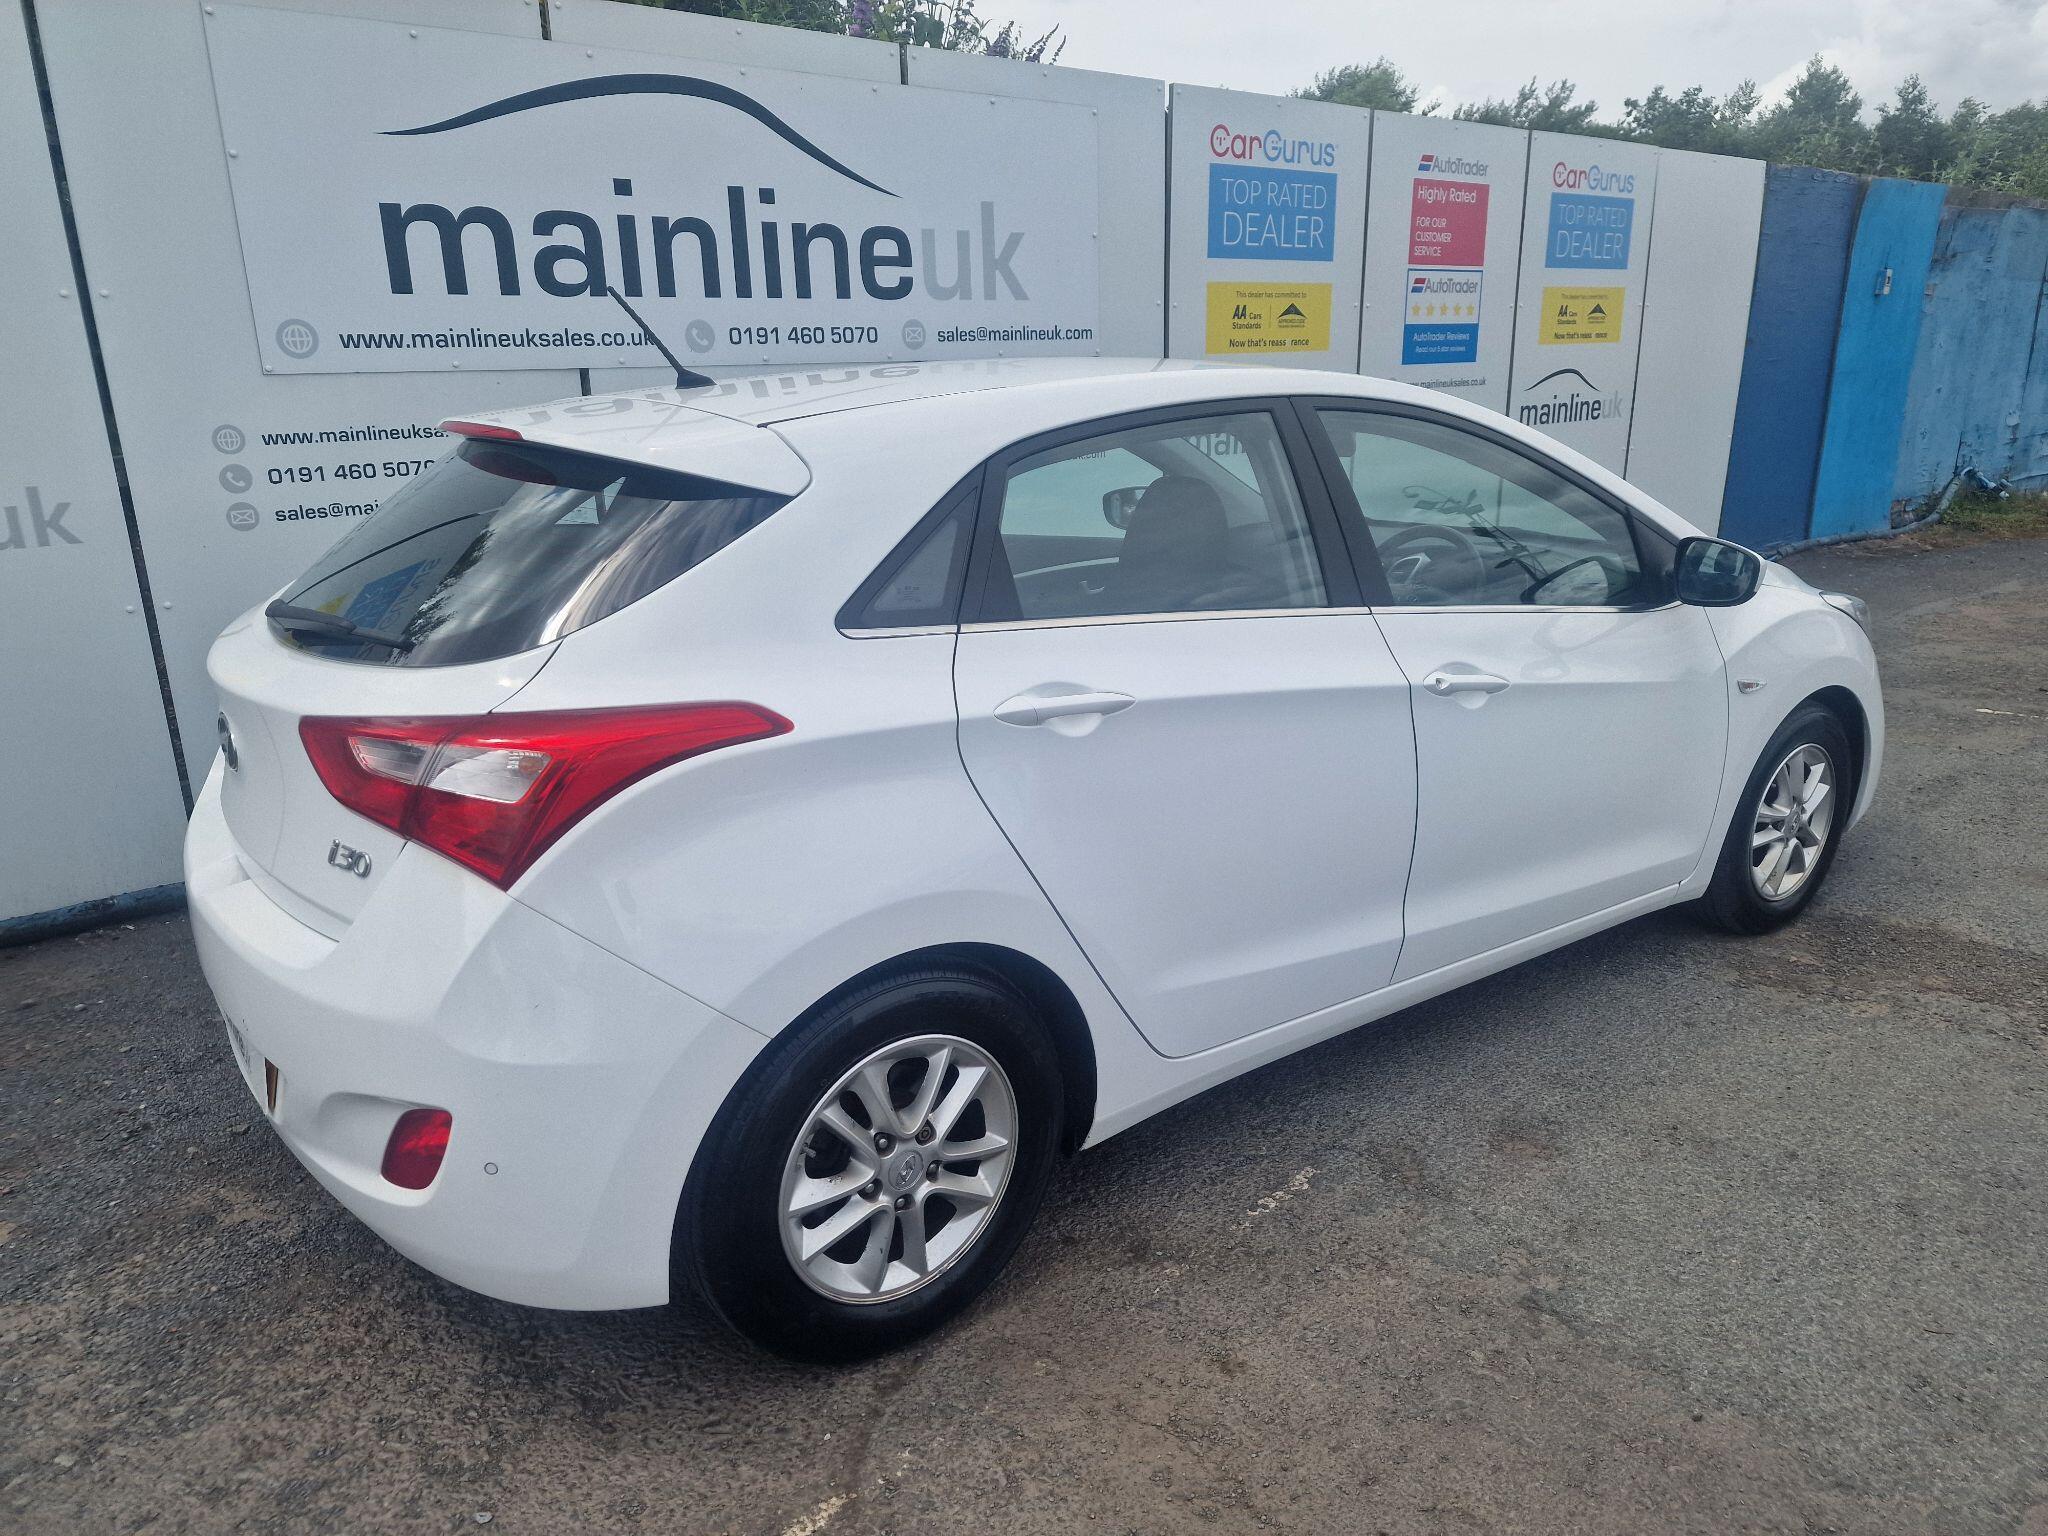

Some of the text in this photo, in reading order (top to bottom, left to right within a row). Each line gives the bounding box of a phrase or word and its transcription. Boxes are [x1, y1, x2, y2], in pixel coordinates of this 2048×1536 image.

[1210, 124, 1336, 167] CarGurus
[1432, 156, 1489, 177] AutoTrader
[1552, 162, 1635, 193] CarGurus
[1222, 178, 1327, 209] TOP RATED
[1417, 186, 1477, 204] Highly Rated
[1416, 217, 1447, 228] FOR OUR
[1557, 203, 1627, 228] TOP RATED
[1223, 211, 1325, 249] DEALER
[1415, 232, 1452, 243] CUSTOMER
[1414, 246, 1442, 257] SERVICE
[1556, 231, 1623, 259] DEALER
[1424, 277, 1478, 294] AutoTrader
[1232, 304, 1262, 320] AA Cars
[937, 324, 1094, 343] sales@mainlineuk.com
[1232, 321, 1262, 330] Standards
[728, 326, 879, 346] 0191 460 5070
[1229, 339, 1246, 348] Now
[1248, 338, 1267, 347] that's
[268, 465, 325, 485] 0191
[335, 463, 377, 480] 460
[328, 839, 372, 878] i30
